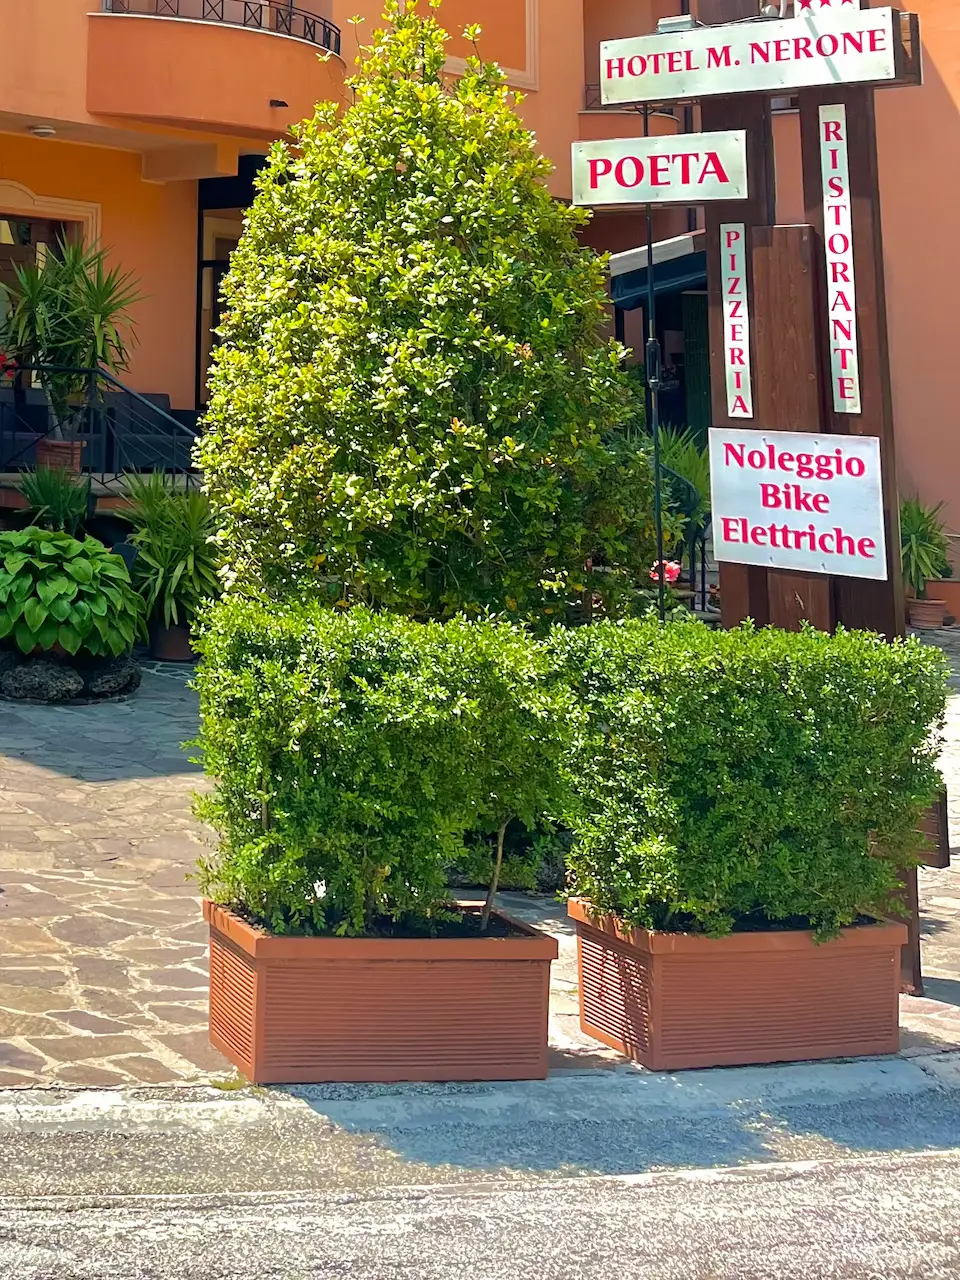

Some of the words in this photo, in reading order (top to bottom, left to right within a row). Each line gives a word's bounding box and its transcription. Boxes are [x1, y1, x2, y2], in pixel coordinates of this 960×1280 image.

[605, 49, 700, 80] HOTEL
[706, 44, 741, 68] M.
[749, 27, 887, 65] NERONE
[587, 151, 730, 190] POETA
[823, 120, 855, 400] RISTORANTE
[725, 230, 750, 414] PIZZERIA
[723, 442, 866, 480] Noleggio
[760, 483, 830, 514] Bike
[721, 517, 876, 559] Elettriche
